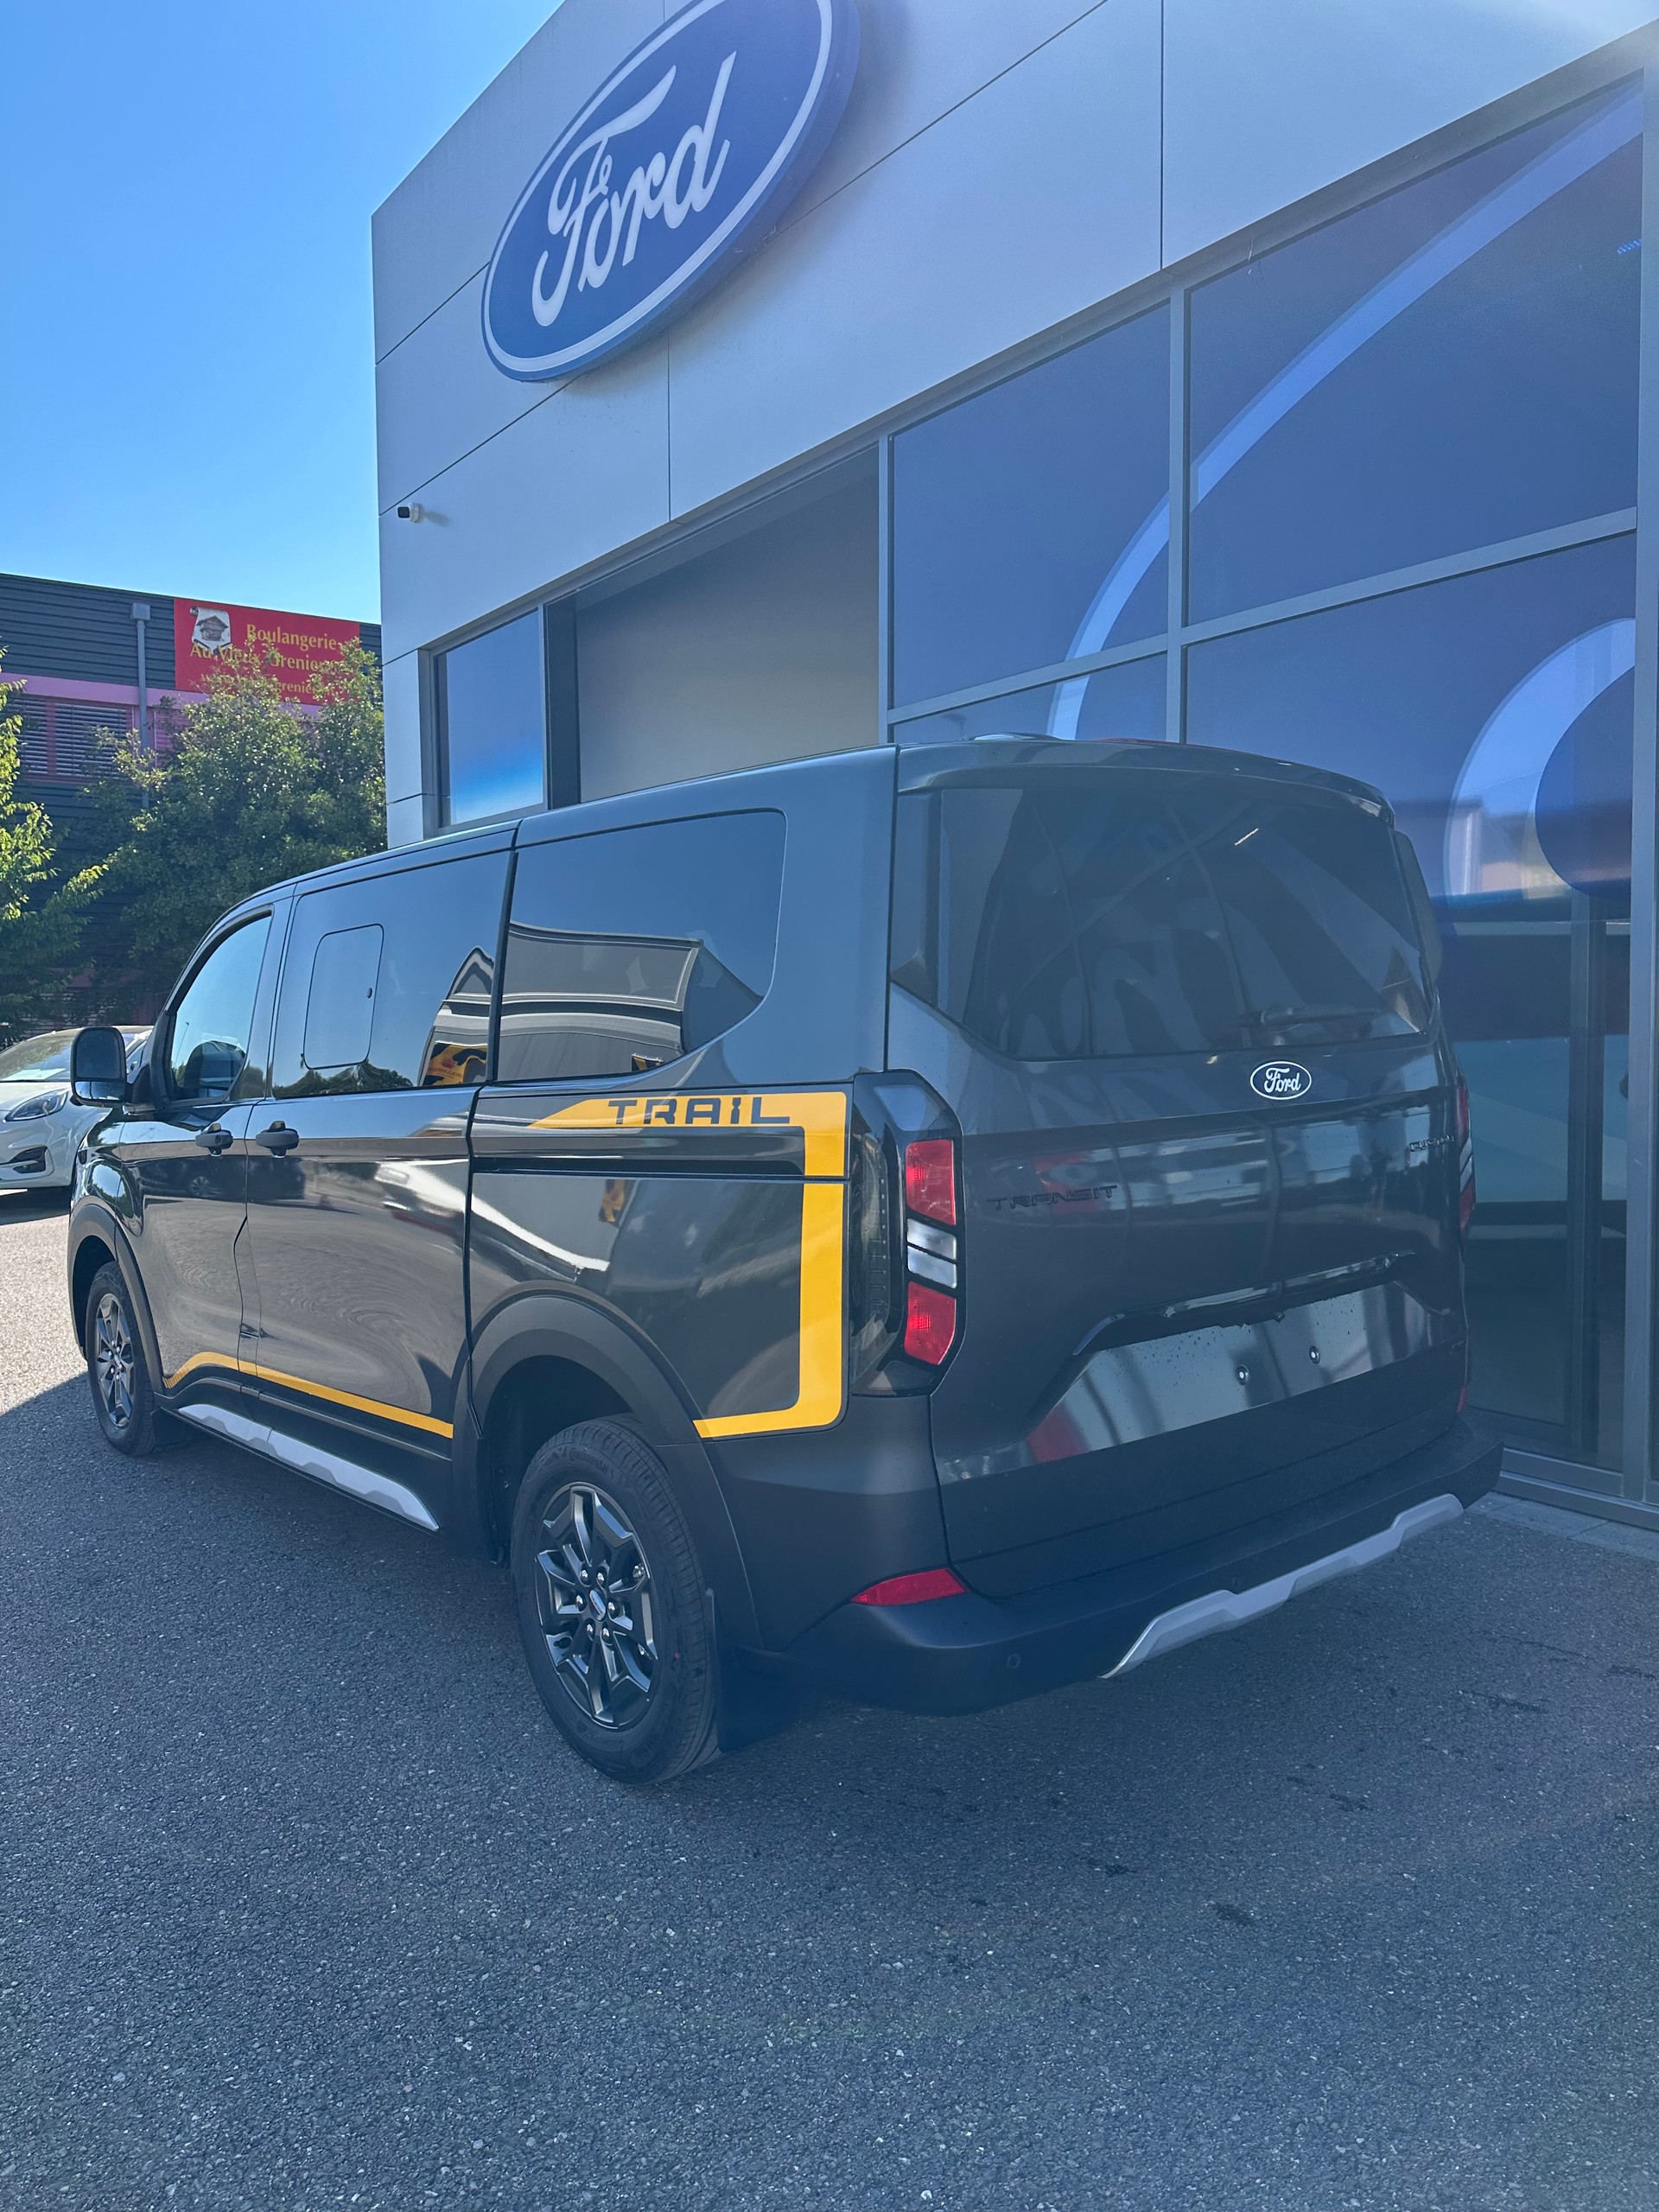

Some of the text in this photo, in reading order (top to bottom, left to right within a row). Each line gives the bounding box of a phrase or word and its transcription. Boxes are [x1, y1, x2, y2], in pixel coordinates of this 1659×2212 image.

[531, 50, 737, 327] Ford
[190, 641, 213, 659] Au
[246, 623, 337, 652] Boulangerie
[1263, 1067, 1301, 1093] Ford
[607, 1096, 791, 1125] TRAIL
[987, 1185, 1118, 1211] TRANSIT
